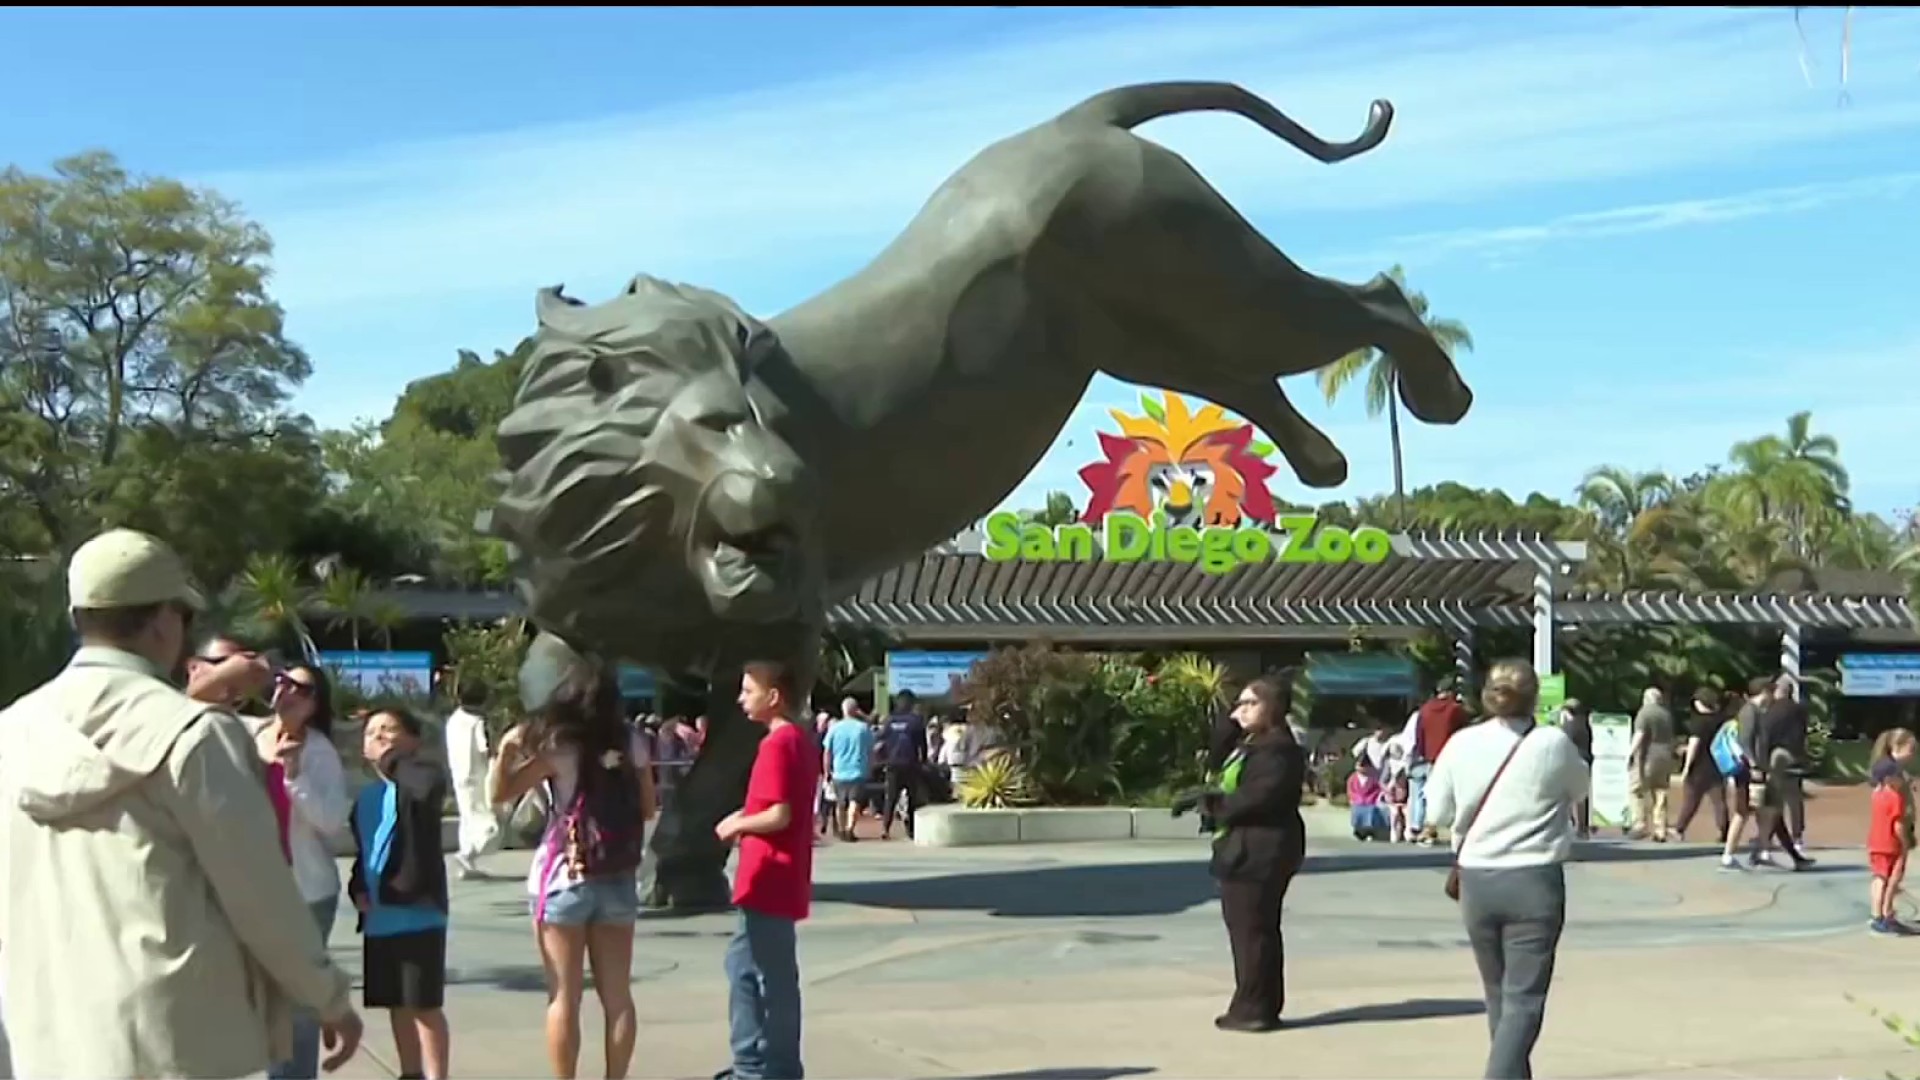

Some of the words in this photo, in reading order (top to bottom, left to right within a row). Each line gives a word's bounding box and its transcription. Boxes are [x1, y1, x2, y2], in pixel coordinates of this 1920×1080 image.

[983, 512, 1093, 562] San
[1103, 509, 1273, 574] Diego
[1276, 513, 1392, 562] Zoo
